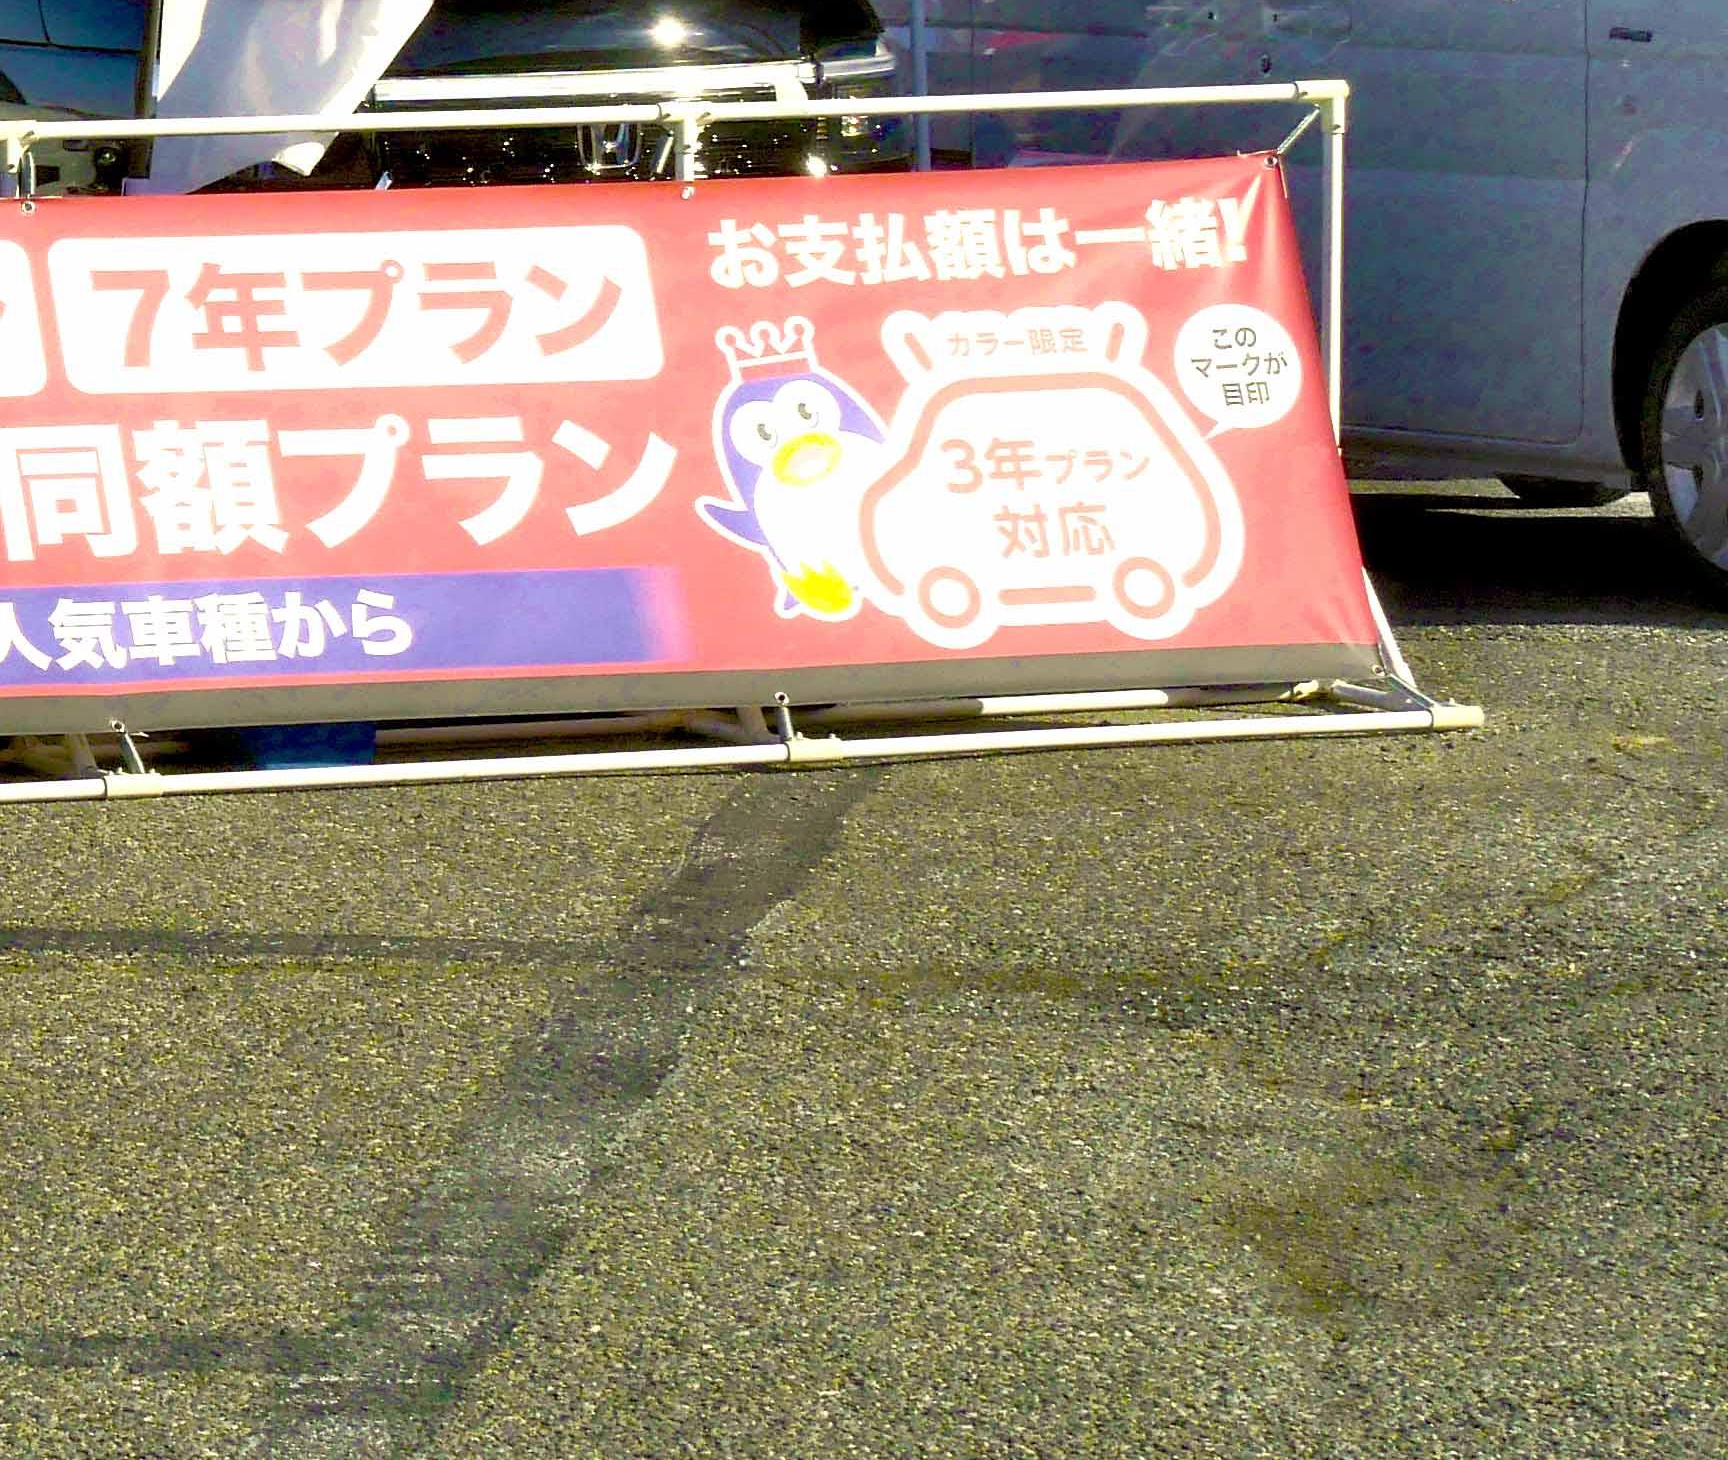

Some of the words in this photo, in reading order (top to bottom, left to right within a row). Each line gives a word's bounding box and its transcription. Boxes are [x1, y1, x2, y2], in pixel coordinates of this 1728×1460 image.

[707, 196, 1247, 288] お支払額は一緒!
[90, 258, 623, 372] 7年プラン
[946, 327, 1089, 358] カラー限定
[1212, 325, 1256, 350] この
[1190, 350, 1289, 377] マークが
[1222, 381, 1269, 407] 目印
[941, 436, 1151, 494] 3年プラン
[993, 503, 1116, 560] 対応
